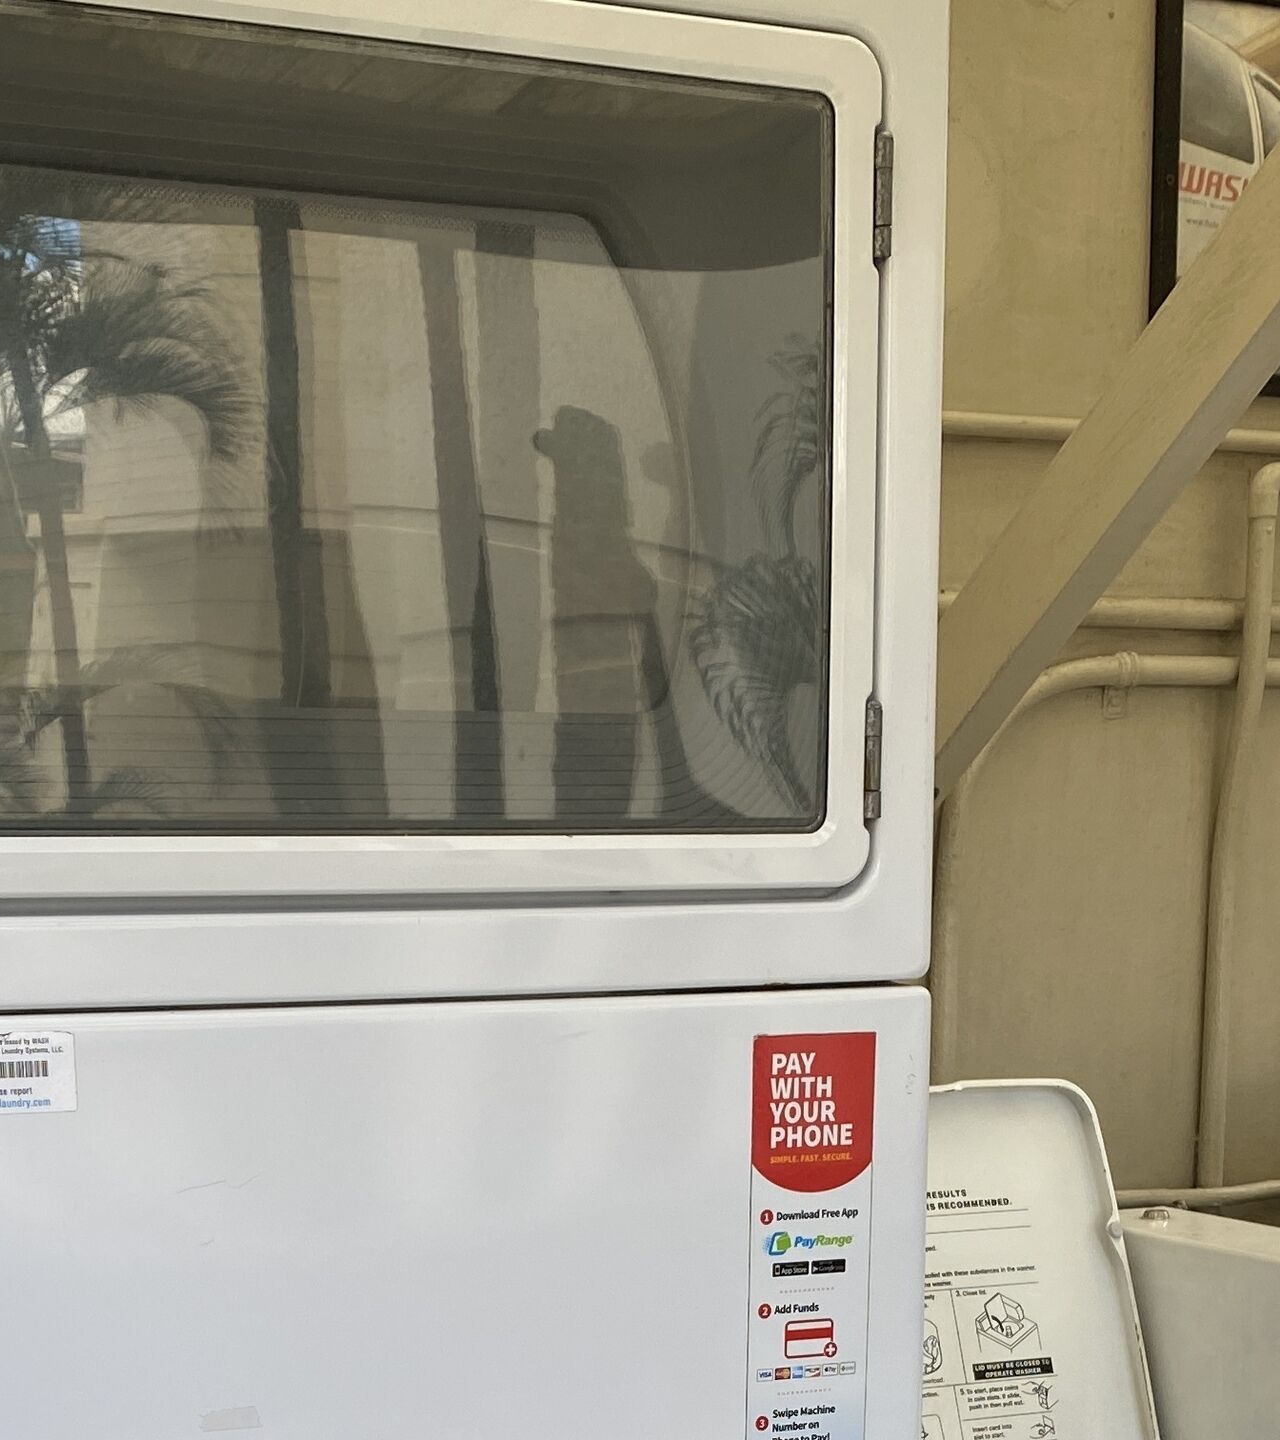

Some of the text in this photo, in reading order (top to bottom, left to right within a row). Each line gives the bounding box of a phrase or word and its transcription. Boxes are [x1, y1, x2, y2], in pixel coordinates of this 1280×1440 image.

[1179, 161, 1248, 202] WAS
[771, 1052, 816, 1075] PAY
[10, 1087, 33, 1096] report
[770, 1076, 832, 1100] WITH
[769, 1100, 836, 1124] YOUR
[770, 1123, 853, 1149] PHONE
[770, 1152, 853, 1164] SIMPLE. FAST. SECURE.
[926, 1189, 967, 1199] RESULTS
[938, 1198, 1012, 1210] RECOMMENDED.
[776, 1209, 820, 1221] Download
[822, 1208, 840, 1218] Free
[841, 1208, 858, 1219] App
[794, 1235, 853, 1249] PayRange
[774, 1304, 791, 1315] Add
[793, 1302, 819, 1313] Funds
[773, 1405, 835, 1419] Swipe Machine
[772, 1421, 807, 1432] Number
[808, 1421, 819, 1429] on
